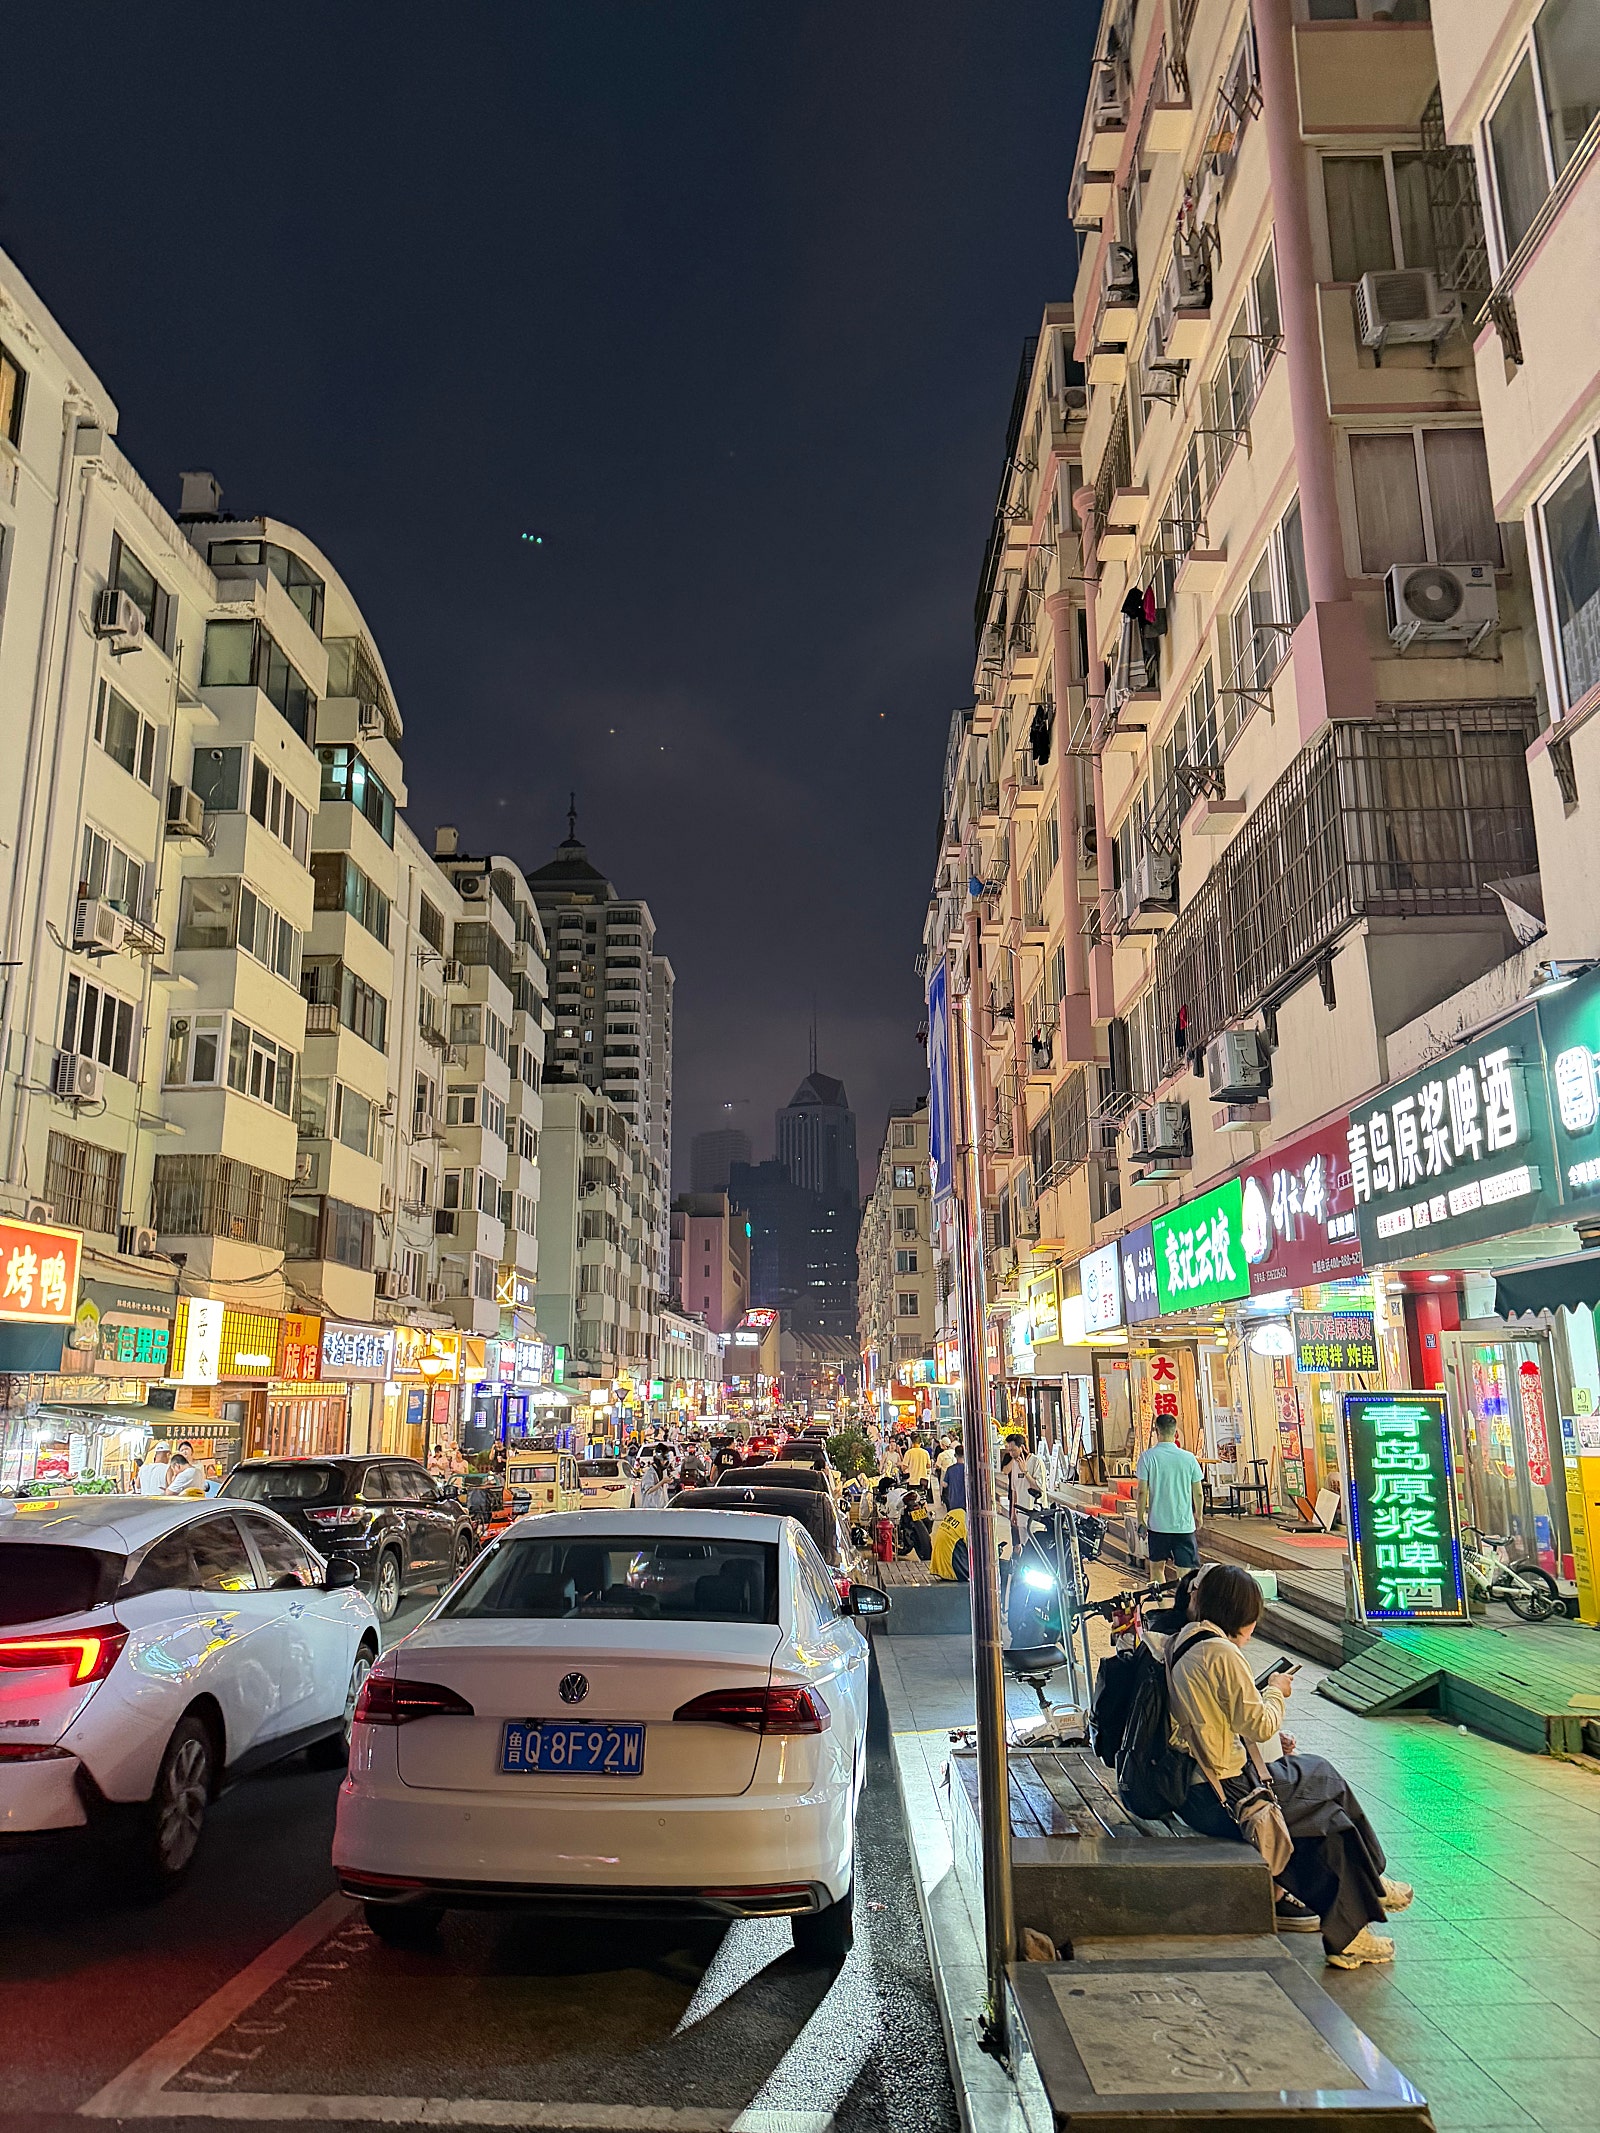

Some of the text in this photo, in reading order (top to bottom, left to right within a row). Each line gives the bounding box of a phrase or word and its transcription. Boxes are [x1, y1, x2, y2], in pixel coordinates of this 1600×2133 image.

[1347, 1047, 1517, 1205] 青岛原浆啤酒
[0, 1244, 67, 1312] 烤鸭
[1165, 1207, 1236, 1297] 袁记云饺
[284, 1343, 318, 1380] 旅馆
[1298, 1315, 1372, 1341] 刘文祥麻辣烫
[1301, 1343, 1375, 1368] 麻辣拌 炸串
[1151, 1357, 1181, 1449] 大锅
[1361, 1405, 1444, 1610] 青岛原浆啤酒
